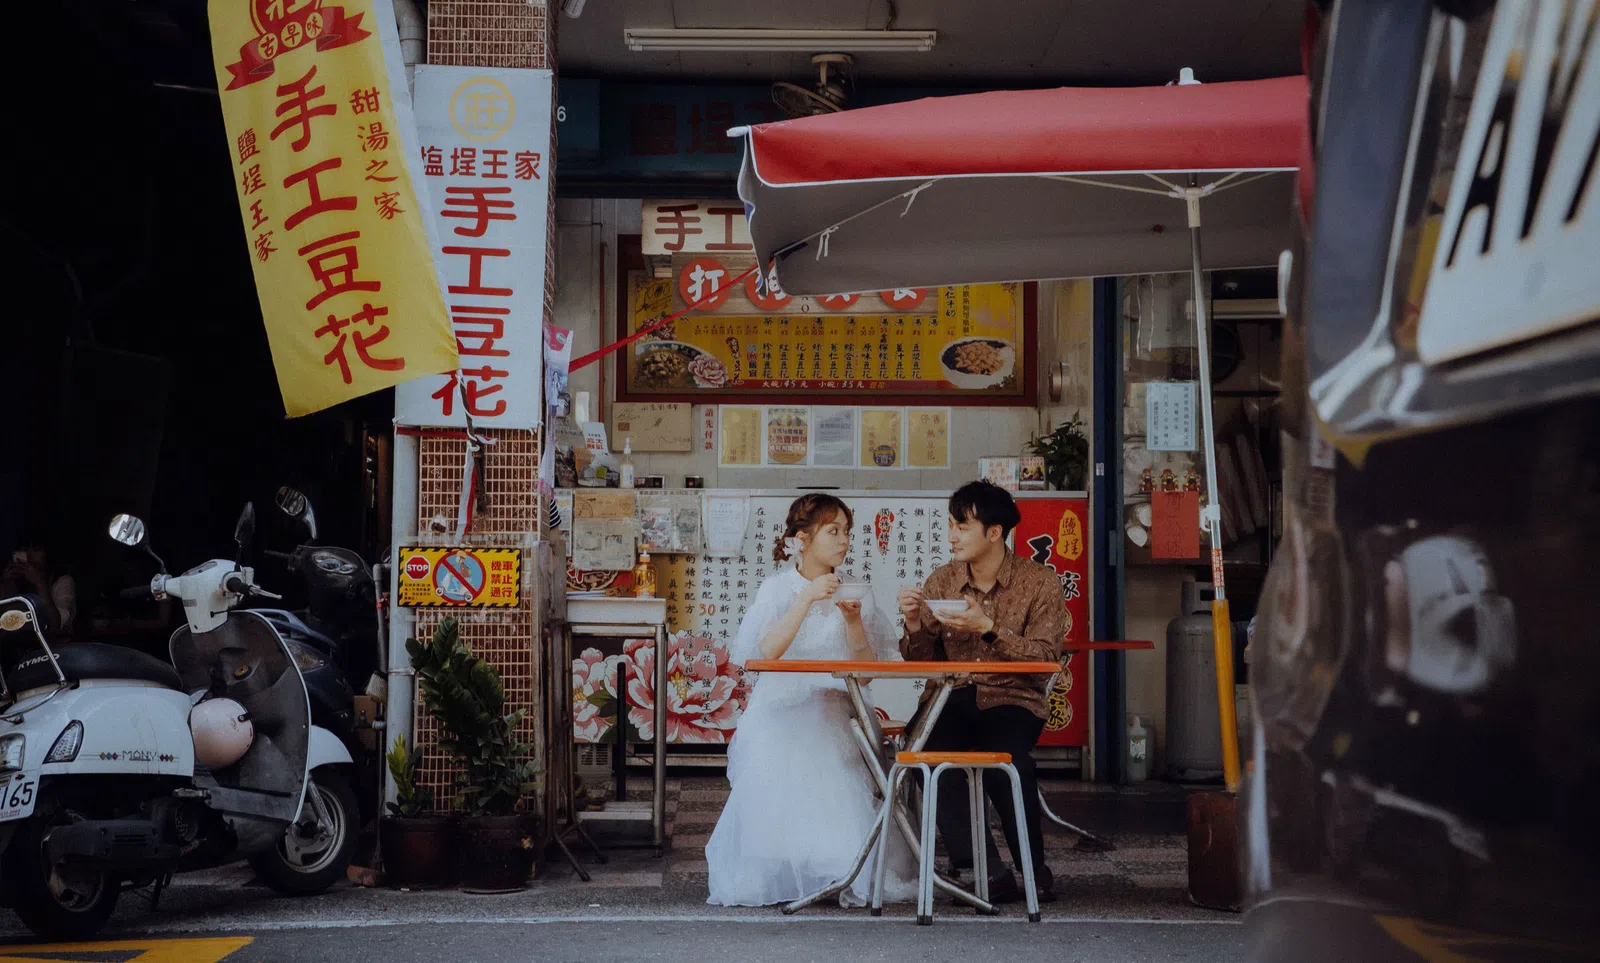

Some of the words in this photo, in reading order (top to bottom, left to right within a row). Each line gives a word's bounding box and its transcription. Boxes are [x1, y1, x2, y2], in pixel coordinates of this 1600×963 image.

[260, 16, 322, 57] 古早味
[350, 88, 405, 220] 甜湯之家
[237, 128, 278, 263] 鹽埕王家
[270, 64, 405, 384] 手工豆花
[655, 204, 753, 251] 手工
[432, 187, 517, 416] 手工豆花
[491, 560, 513, 571] 機車
[491, 573, 513, 584] 禁止
[491, 586, 513, 598] 通行
[18, 653, 60, 670] KYMCO
